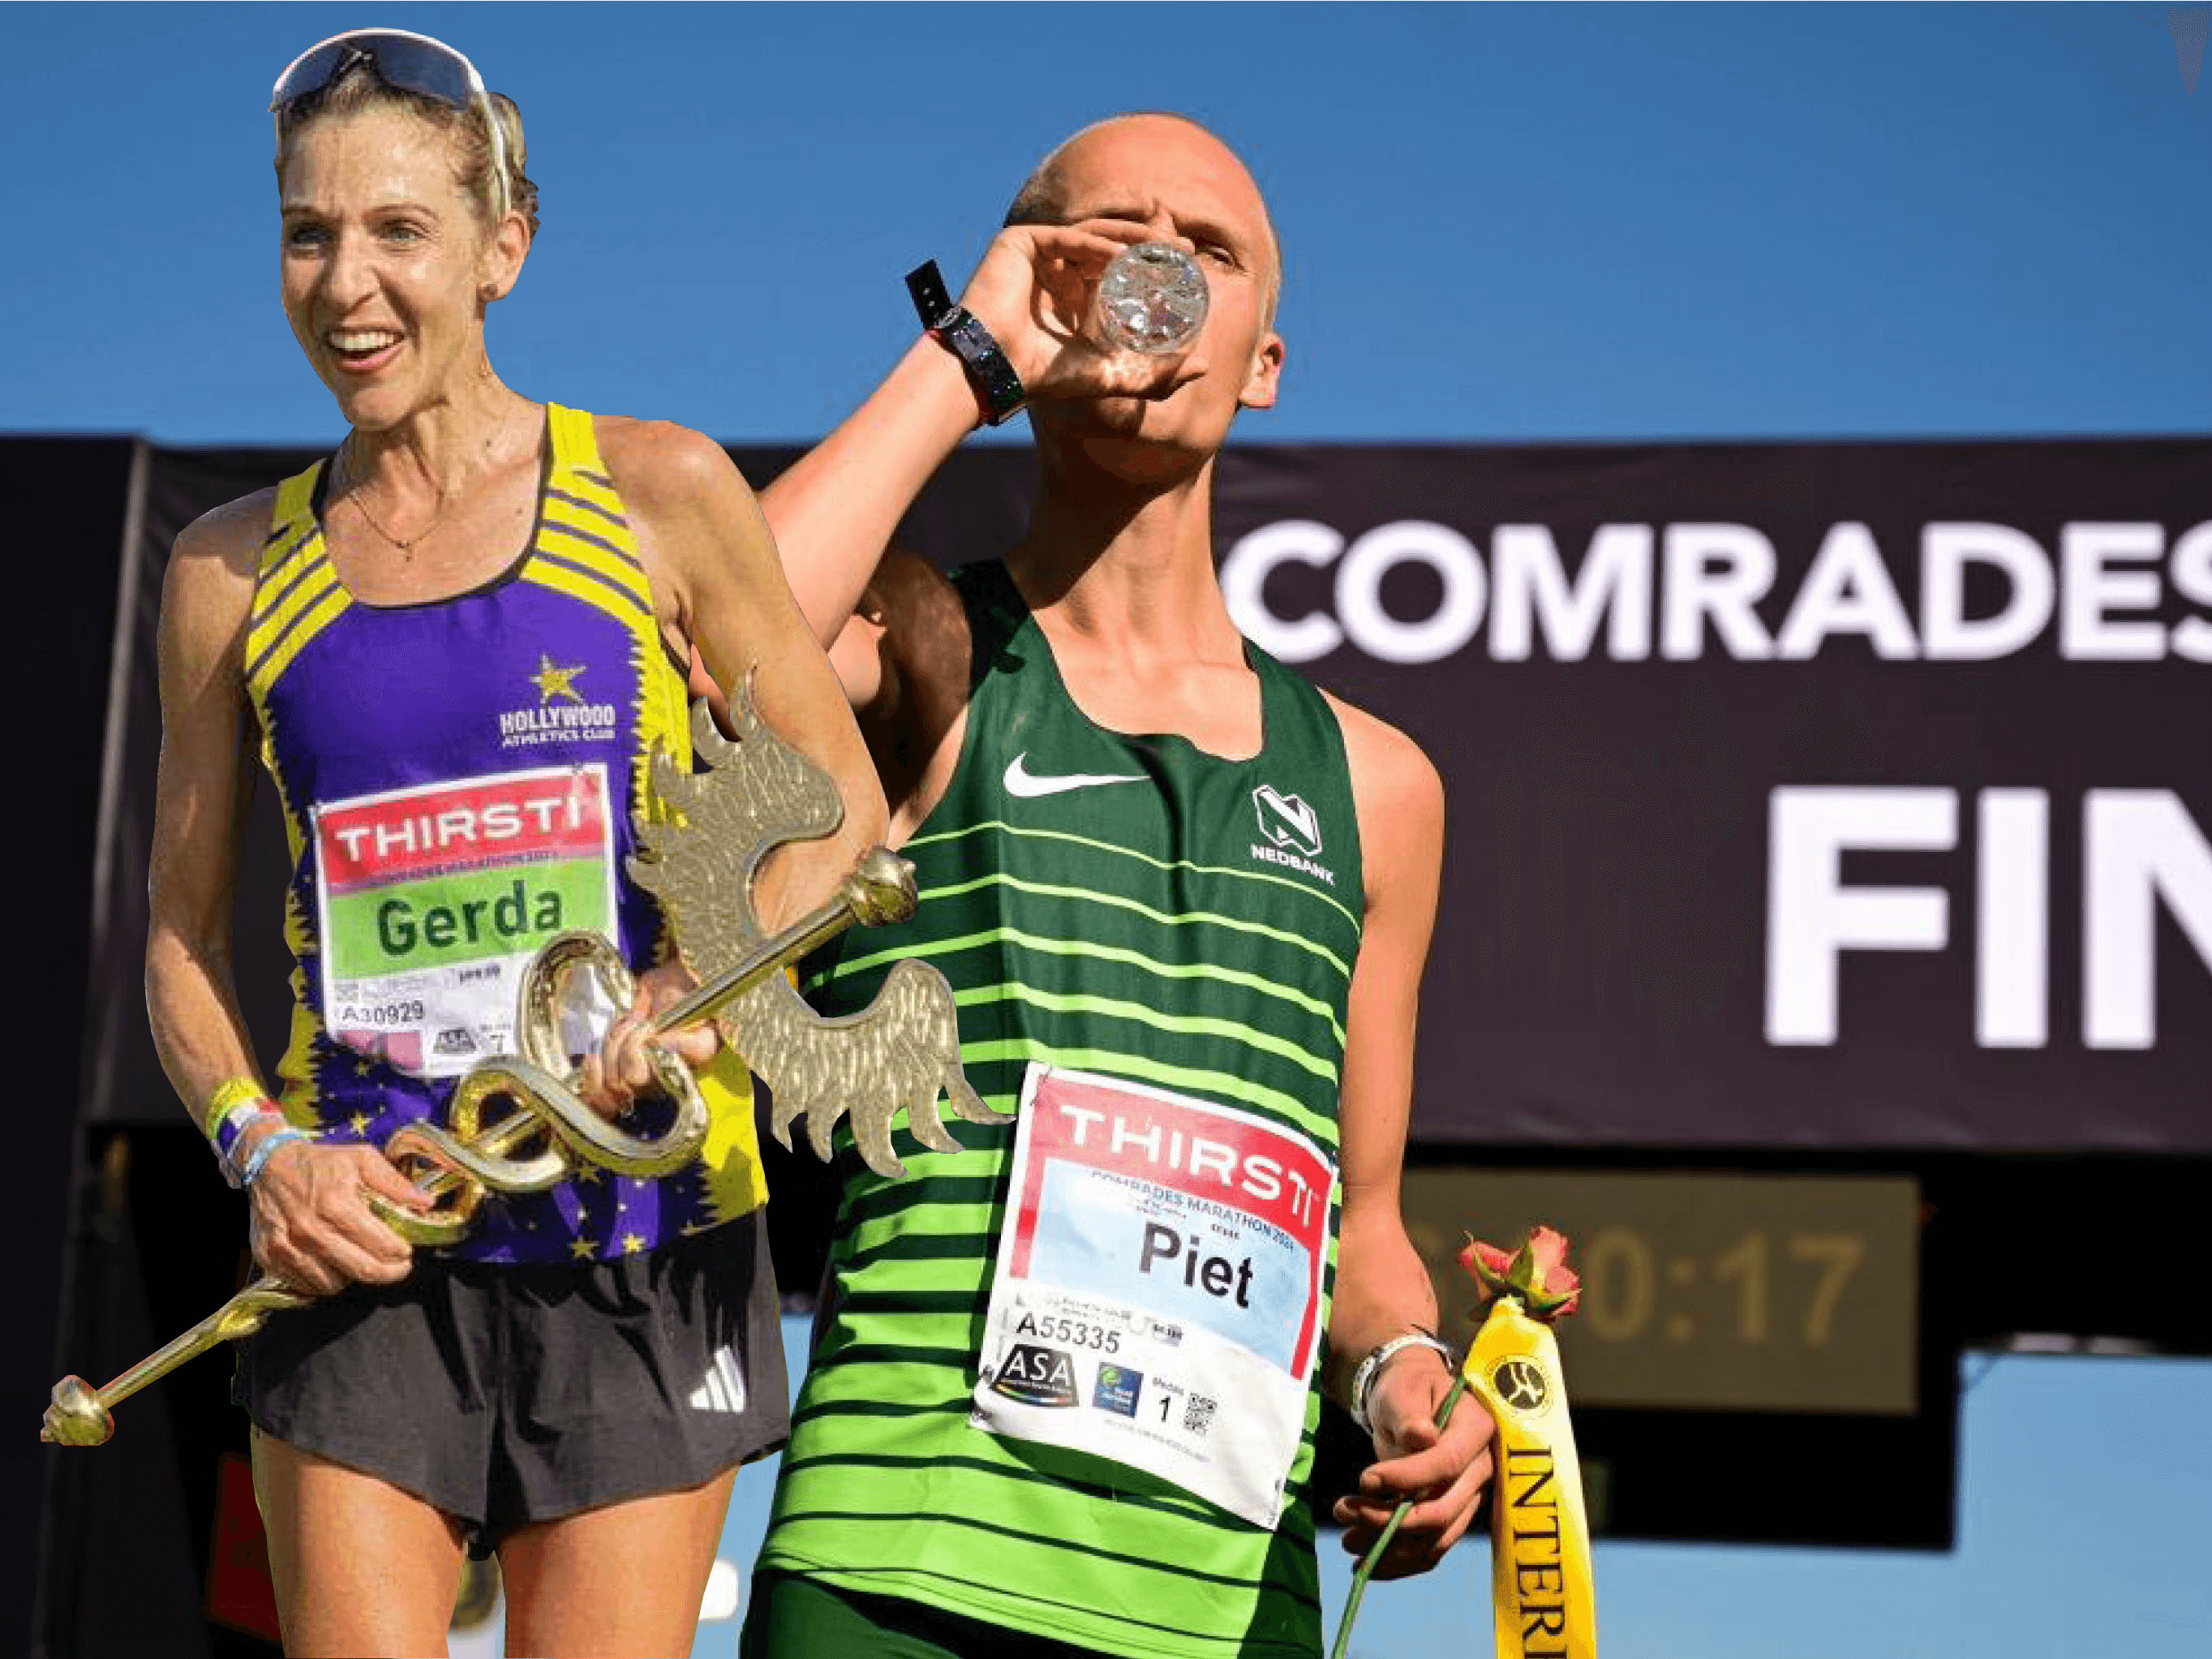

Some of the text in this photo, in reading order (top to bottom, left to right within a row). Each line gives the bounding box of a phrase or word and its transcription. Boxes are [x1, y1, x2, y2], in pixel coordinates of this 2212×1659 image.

[500, 706, 616, 734] HOLLYWOOD
[335, 796, 582, 862] THIRSTI
[1250, 843, 1335, 887] NEDBANK
[376, 878, 562, 956] Gerda
[341, 999, 425, 1025] A30929
[1059, 1104, 1312, 1228] THIRSTI
[1187, 1197, 1272, 1237] MARATHON
[1138, 1220, 1254, 1309] Piet
[1016, 1310, 1122, 1354] A55335
[1004, 1349, 1072, 1387] ASA
[1158, 1395, 1171, 1423] 1
[1506, 1444, 1569, 1659] INTER
